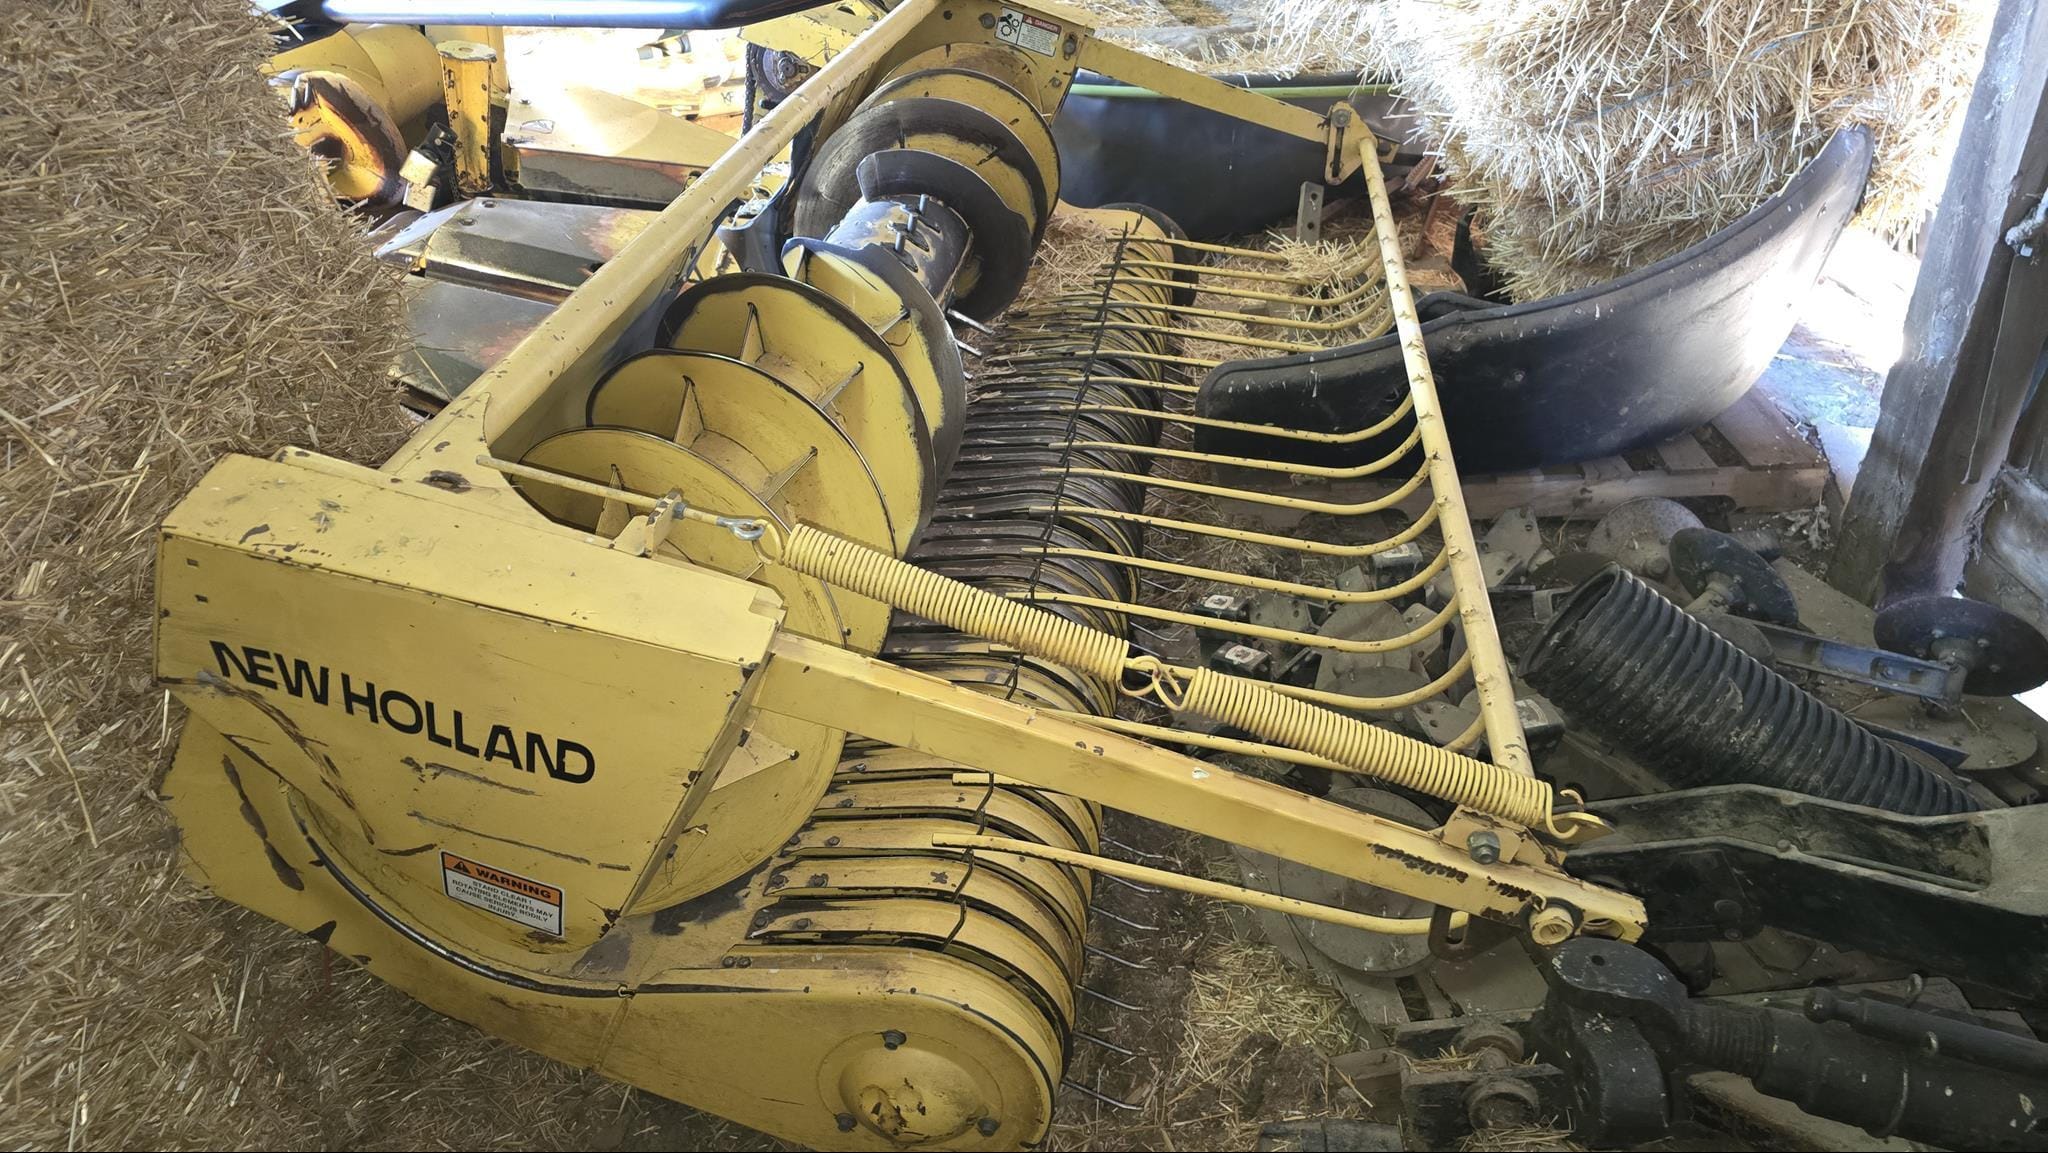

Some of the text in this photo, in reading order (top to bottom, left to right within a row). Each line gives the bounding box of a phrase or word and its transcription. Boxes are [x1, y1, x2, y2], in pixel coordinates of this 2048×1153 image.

[1034, 19, 1058, 33] DANGER
[209, 640, 596, 784] NEW HOLLAND
[452, 879, 553, 918] ROTATING ELEMENTS MAY
[472, 880, 499, 894] STAND
[500, 891, 527, 904] CLEAR
[476, 867, 551, 899] WARNING
[456, 886, 548, 922] CAUSE SERIOUS BODILY
[488, 904, 518, 919] INJURY.
